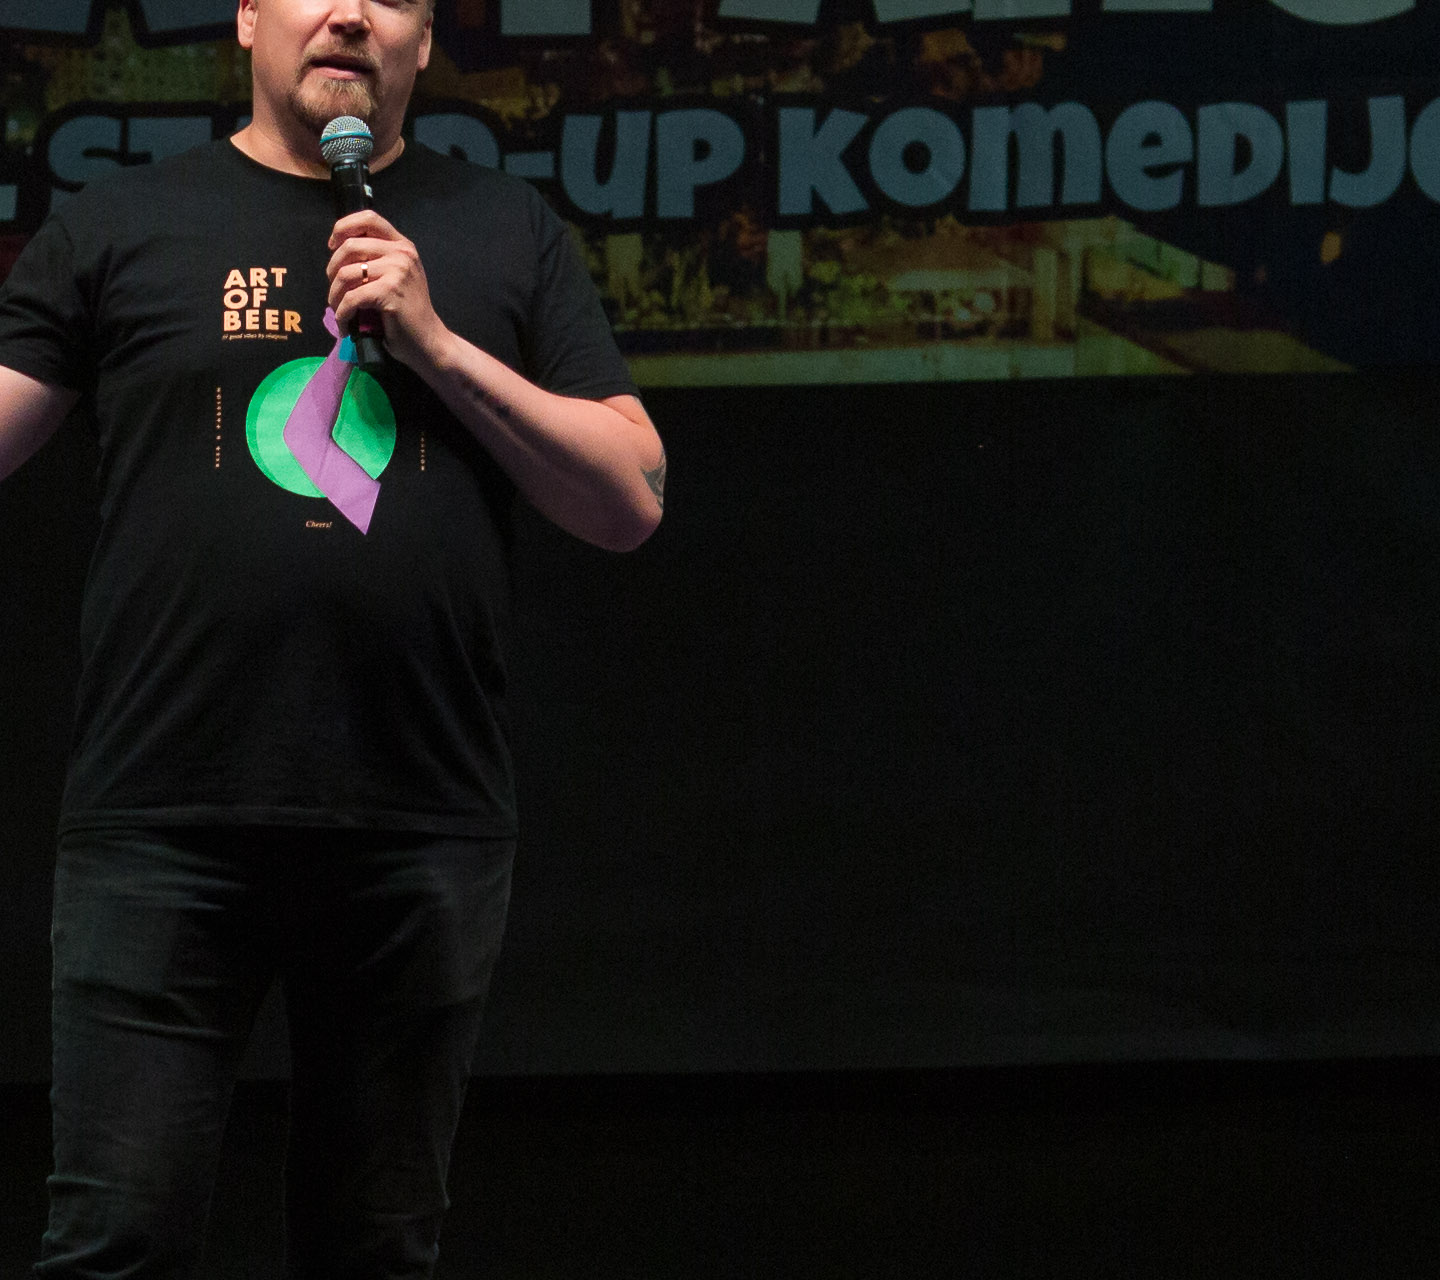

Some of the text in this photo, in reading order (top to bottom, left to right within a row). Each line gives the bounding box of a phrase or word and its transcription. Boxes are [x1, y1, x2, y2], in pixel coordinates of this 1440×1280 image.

[223, 267, 287, 289] ART
[223, 288, 268, 310] OF
[223, 309, 303, 333] BEER
